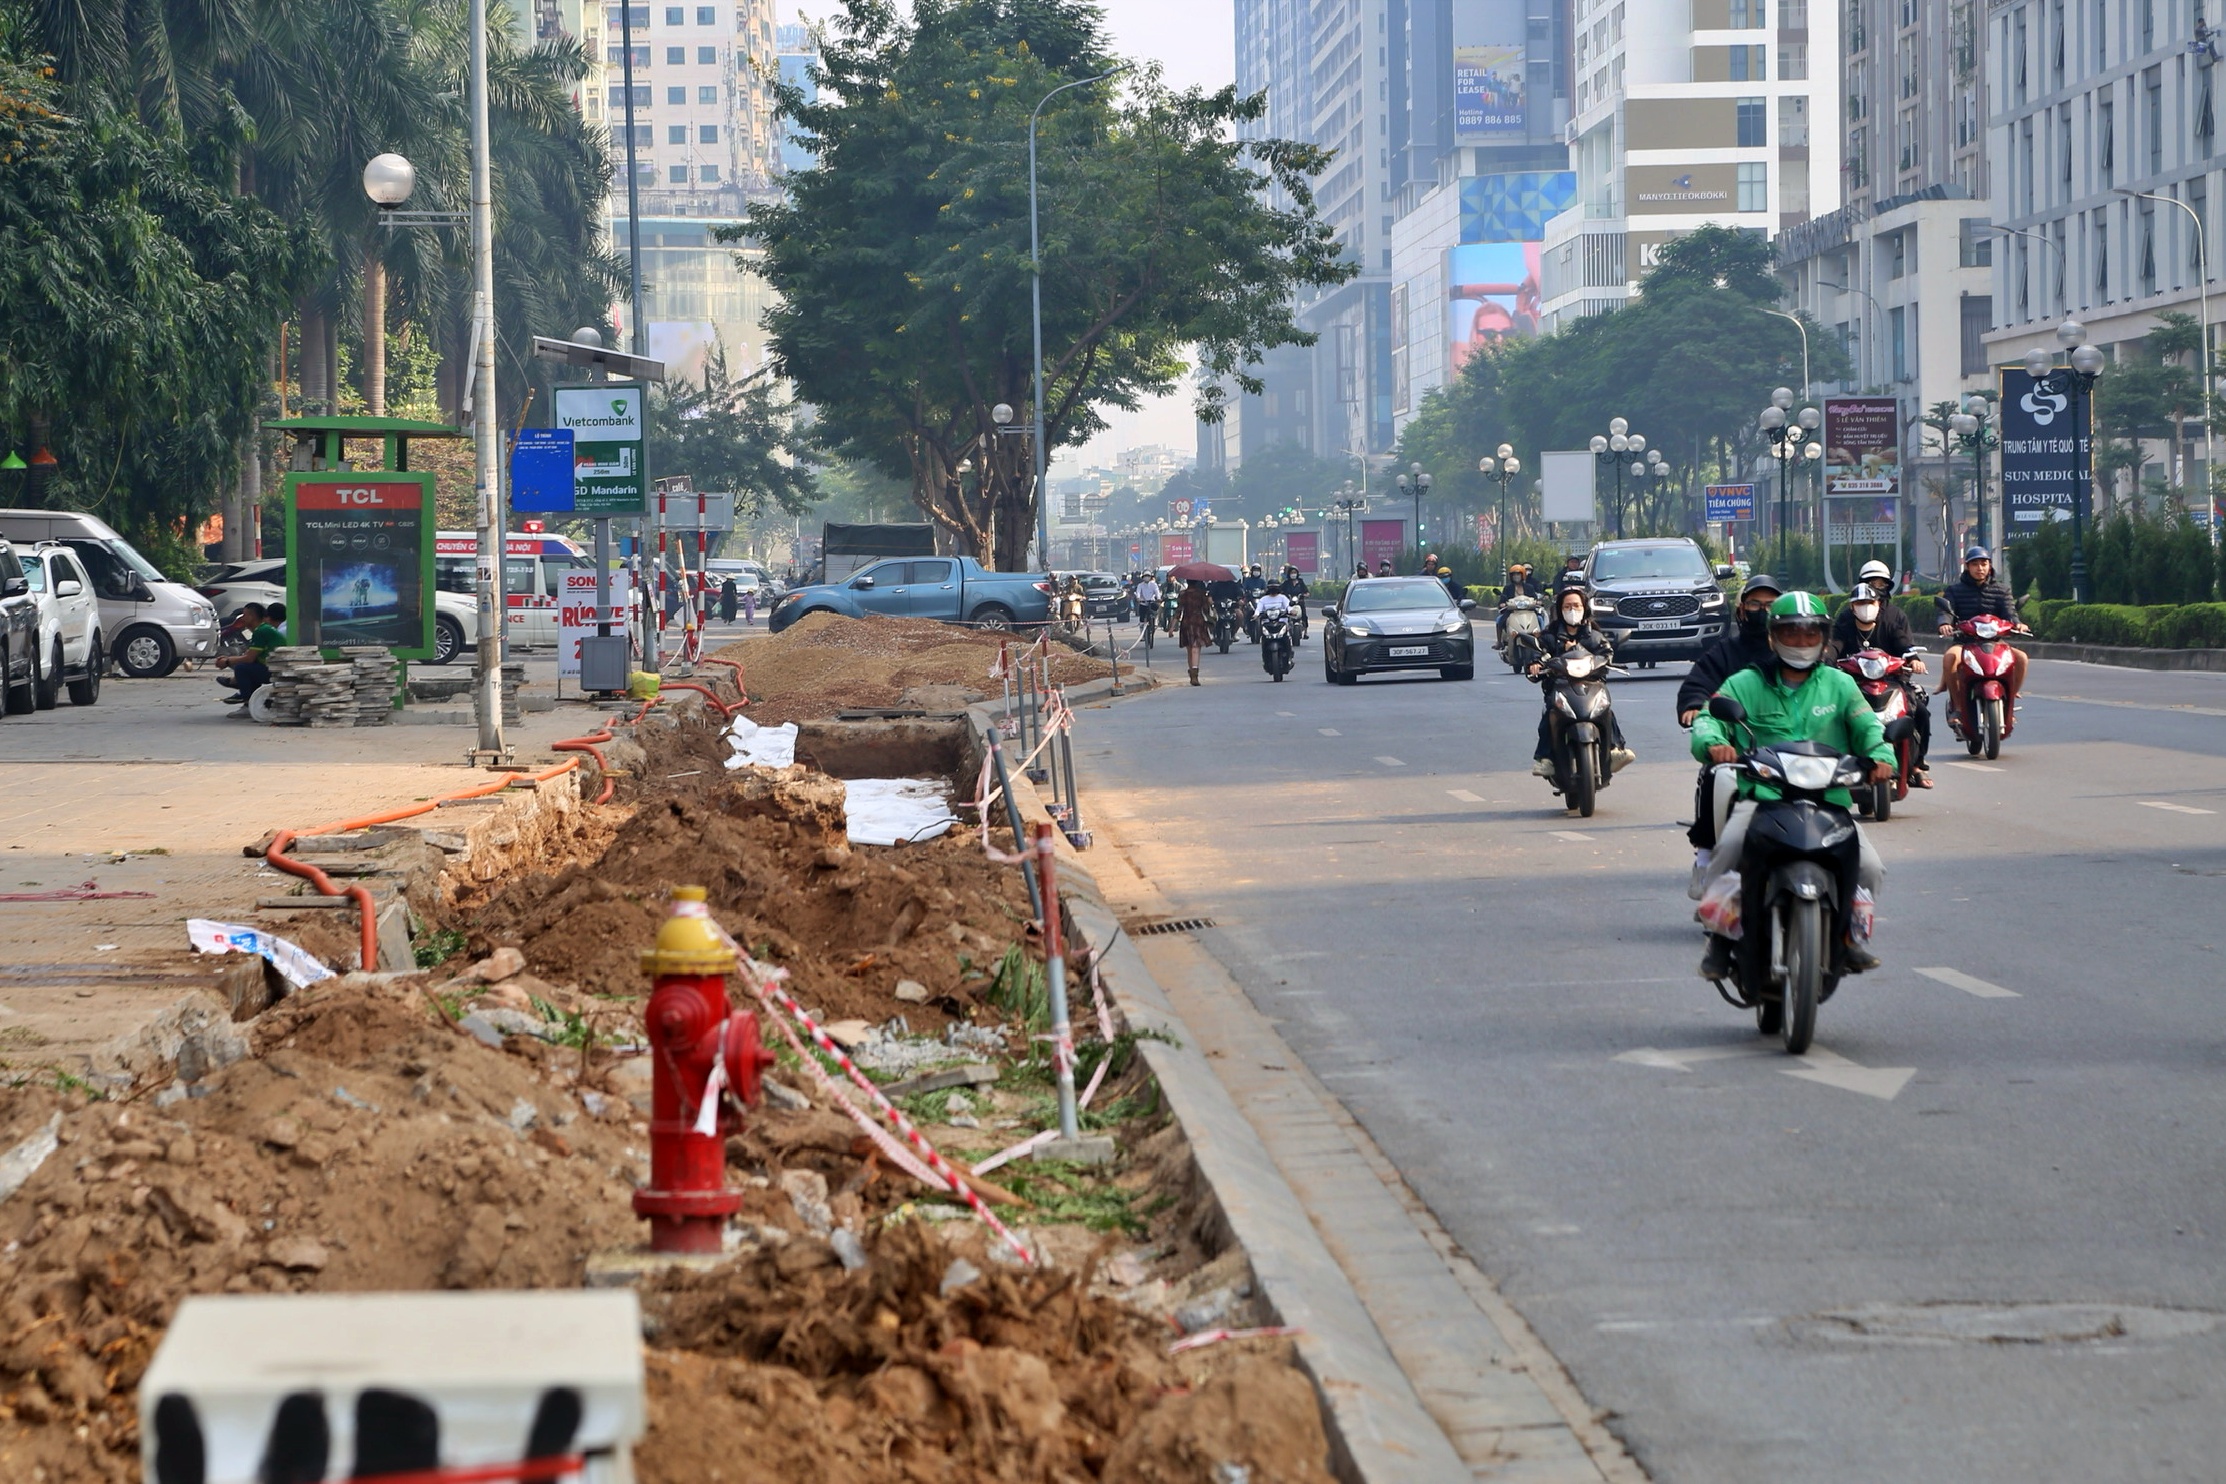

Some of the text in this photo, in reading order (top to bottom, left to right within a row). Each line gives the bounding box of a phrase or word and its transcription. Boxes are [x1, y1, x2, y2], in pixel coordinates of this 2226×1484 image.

[1457, 68, 1487, 78] RETAIL
[1457, 78, 1474, 86] FOR
[1457, 86, 1485, 94] LEASE
[1459, 114, 1522, 125] 0889 886 885
[1639, 193, 1670, 201] MANYO
[562, 415, 635, 427] Vietcombank
[2003, 440, 2027, 454] TRUNG
[2027, 437, 2043, 453] TÂM
[2043, 440, 2048, 453] Y
[2058, 436, 2074, 453] QUỐ
[2004, 471, 2030, 481] SUN
[591, 485, 637, 495] Mandarin
[1719, 486, 1751, 497] VNVC
[336, 488, 383, 504] TCL
[2012, 493, 2082, 505] HOSPITA
[305, 521, 324, 529] TCL
[342, 521, 359, 529] LED
[567, 576, 614, 587] SON
